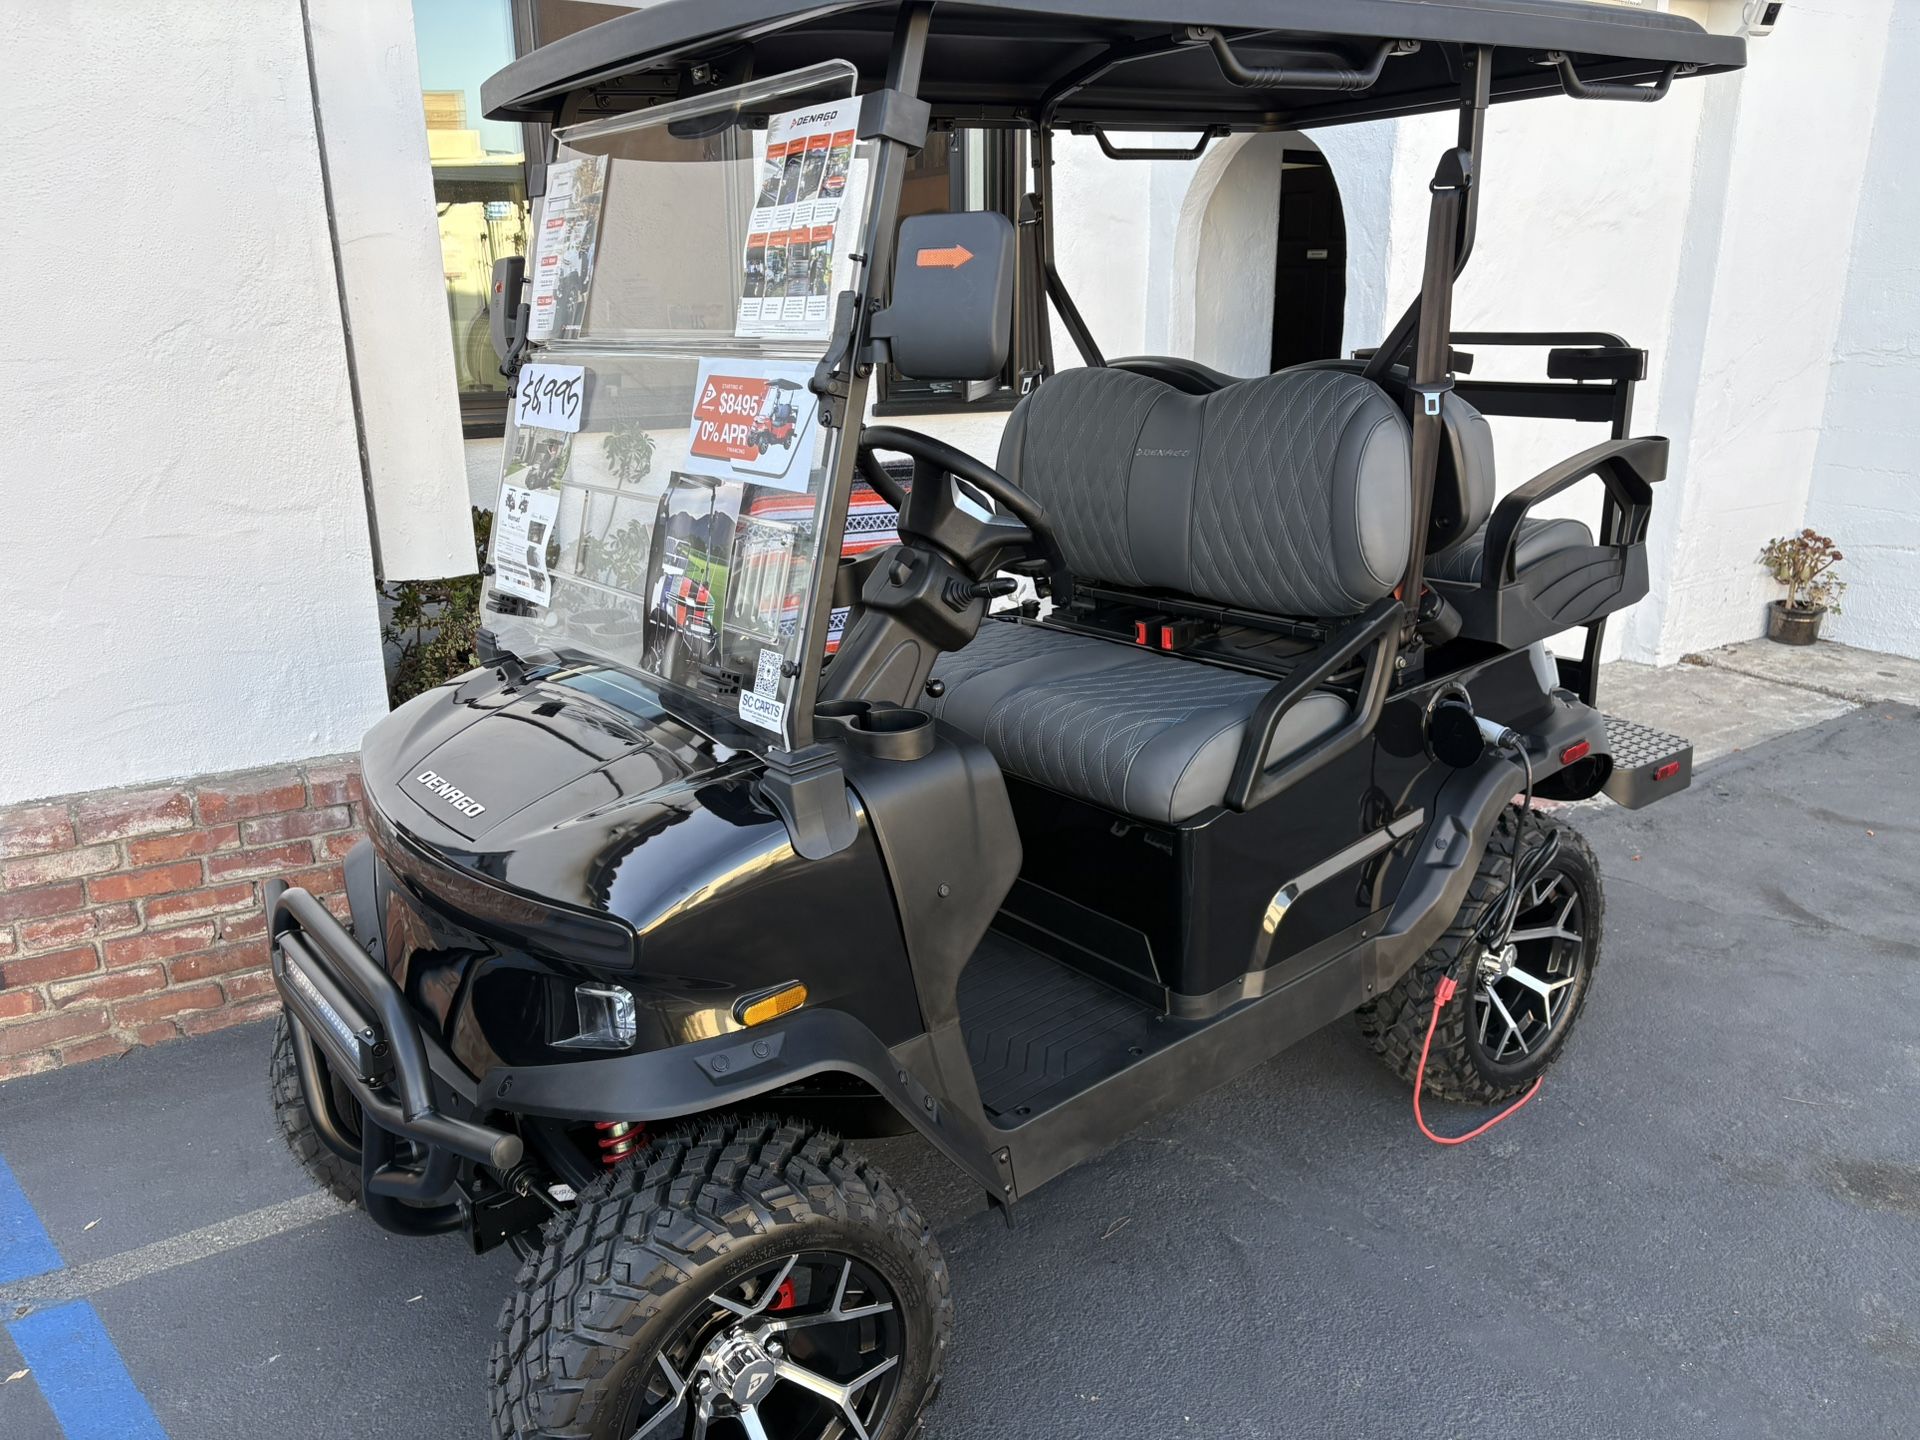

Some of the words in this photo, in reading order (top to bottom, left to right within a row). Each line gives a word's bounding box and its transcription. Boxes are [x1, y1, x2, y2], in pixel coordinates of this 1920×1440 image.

[796, 110, 838, 126] DENAGO
[521, 370, 582, 421] $8,995
[718, 391, 760, 416] $8495
[701, 420, 720, 442] 0%
[719, 422, 748, 446] APR
[742, 693, 755, 708] SC
[754, 698, 781, 718] CARTS
[416, 770, 486, 818] DENAGO
